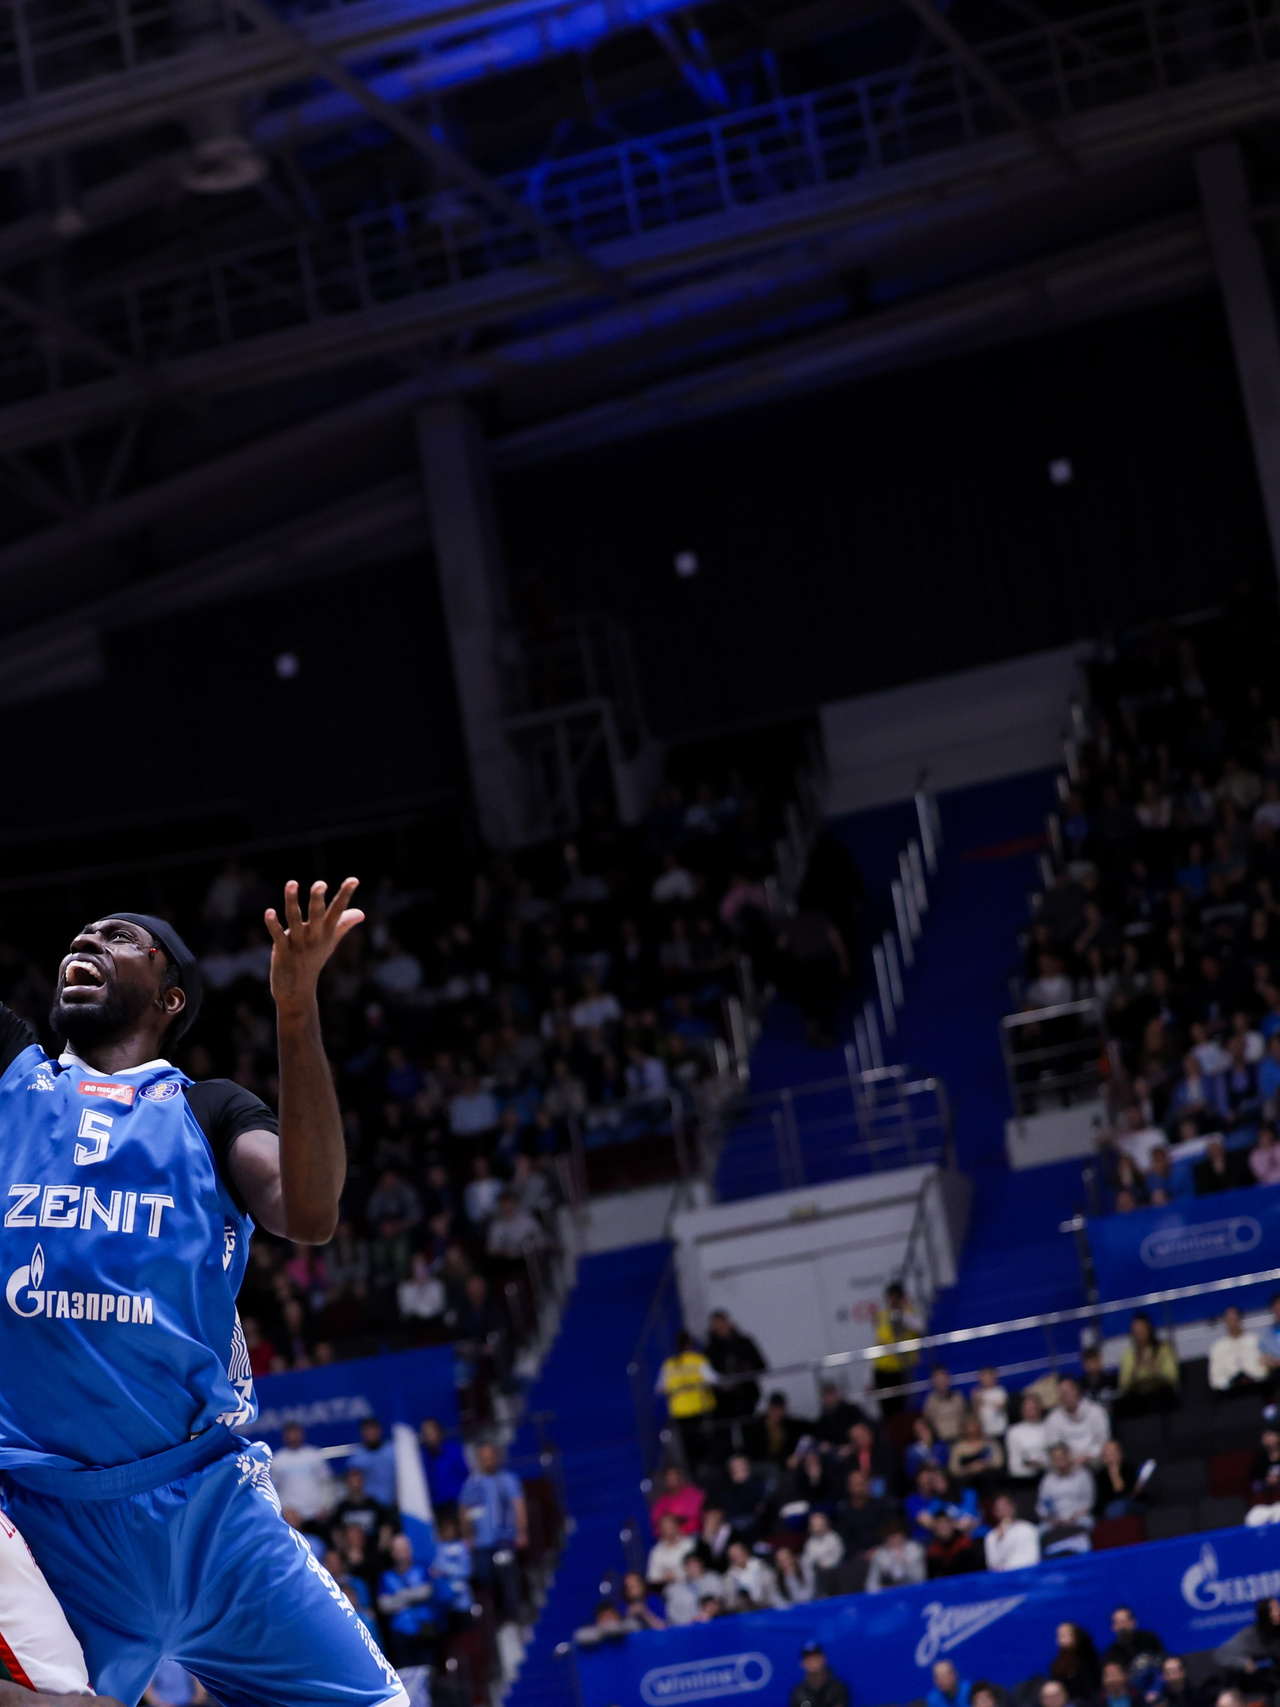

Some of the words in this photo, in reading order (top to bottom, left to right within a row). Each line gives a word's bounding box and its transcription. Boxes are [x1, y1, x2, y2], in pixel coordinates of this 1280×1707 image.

[74, 1108, 114, 1166] 5
[4, 1183, 175, 1238] ZENIT
[46, 1290, 153, 1325] ГАЗПРОМ
